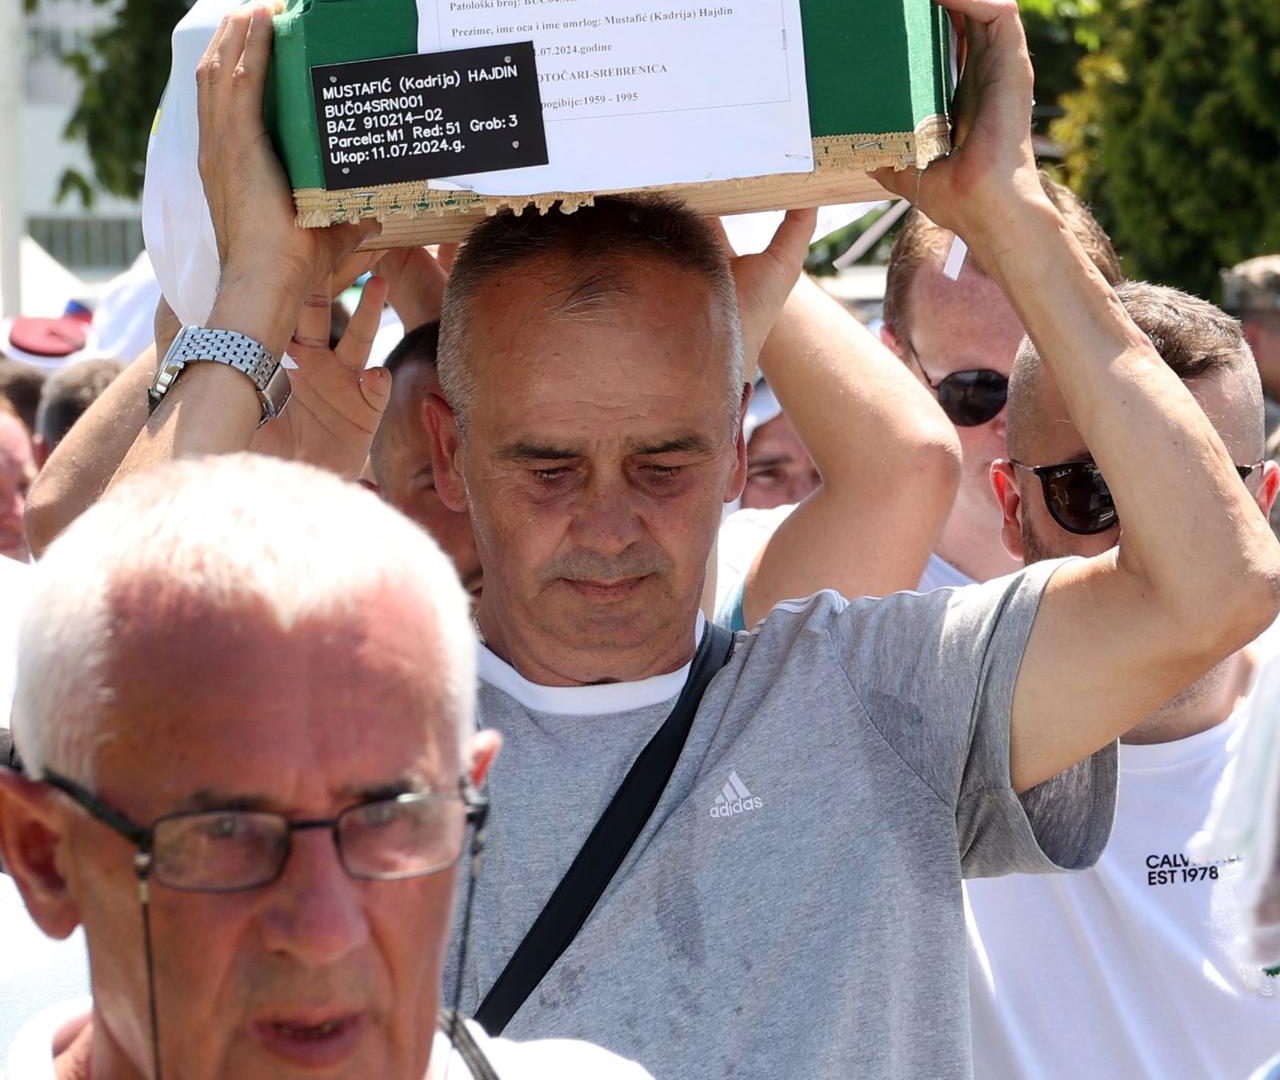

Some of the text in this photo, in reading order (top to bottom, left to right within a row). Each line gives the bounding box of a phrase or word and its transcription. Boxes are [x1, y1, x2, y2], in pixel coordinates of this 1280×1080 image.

[451, 27, 494, 38] Prezime,
[496, 25, 515, 34] ime
[517, 24, 533, 32] oca
[542, 21, 560, 30] ime
[650, 8, 697, 22] (Kadrija)
[699, 6, 733, 19] Hajdin
[535, 43, 613, 57] .07.2024.godine
[322, 65, 518, 100] MUSTAFIĆ (Kadrija) HAJDIN
[537, 64, 668, 82] OTOČARI-SREBRENICA
[325, 95, 424, 119] BUČ04SRN001
[615, 92, 639, 103] 1995
[326, 118, 356, 134] BAZ
[710, 795, 764, 819] adidas
[1145, 853, 1196, 870] CALV
[1147, 865, 1219, 886] EST 1978
